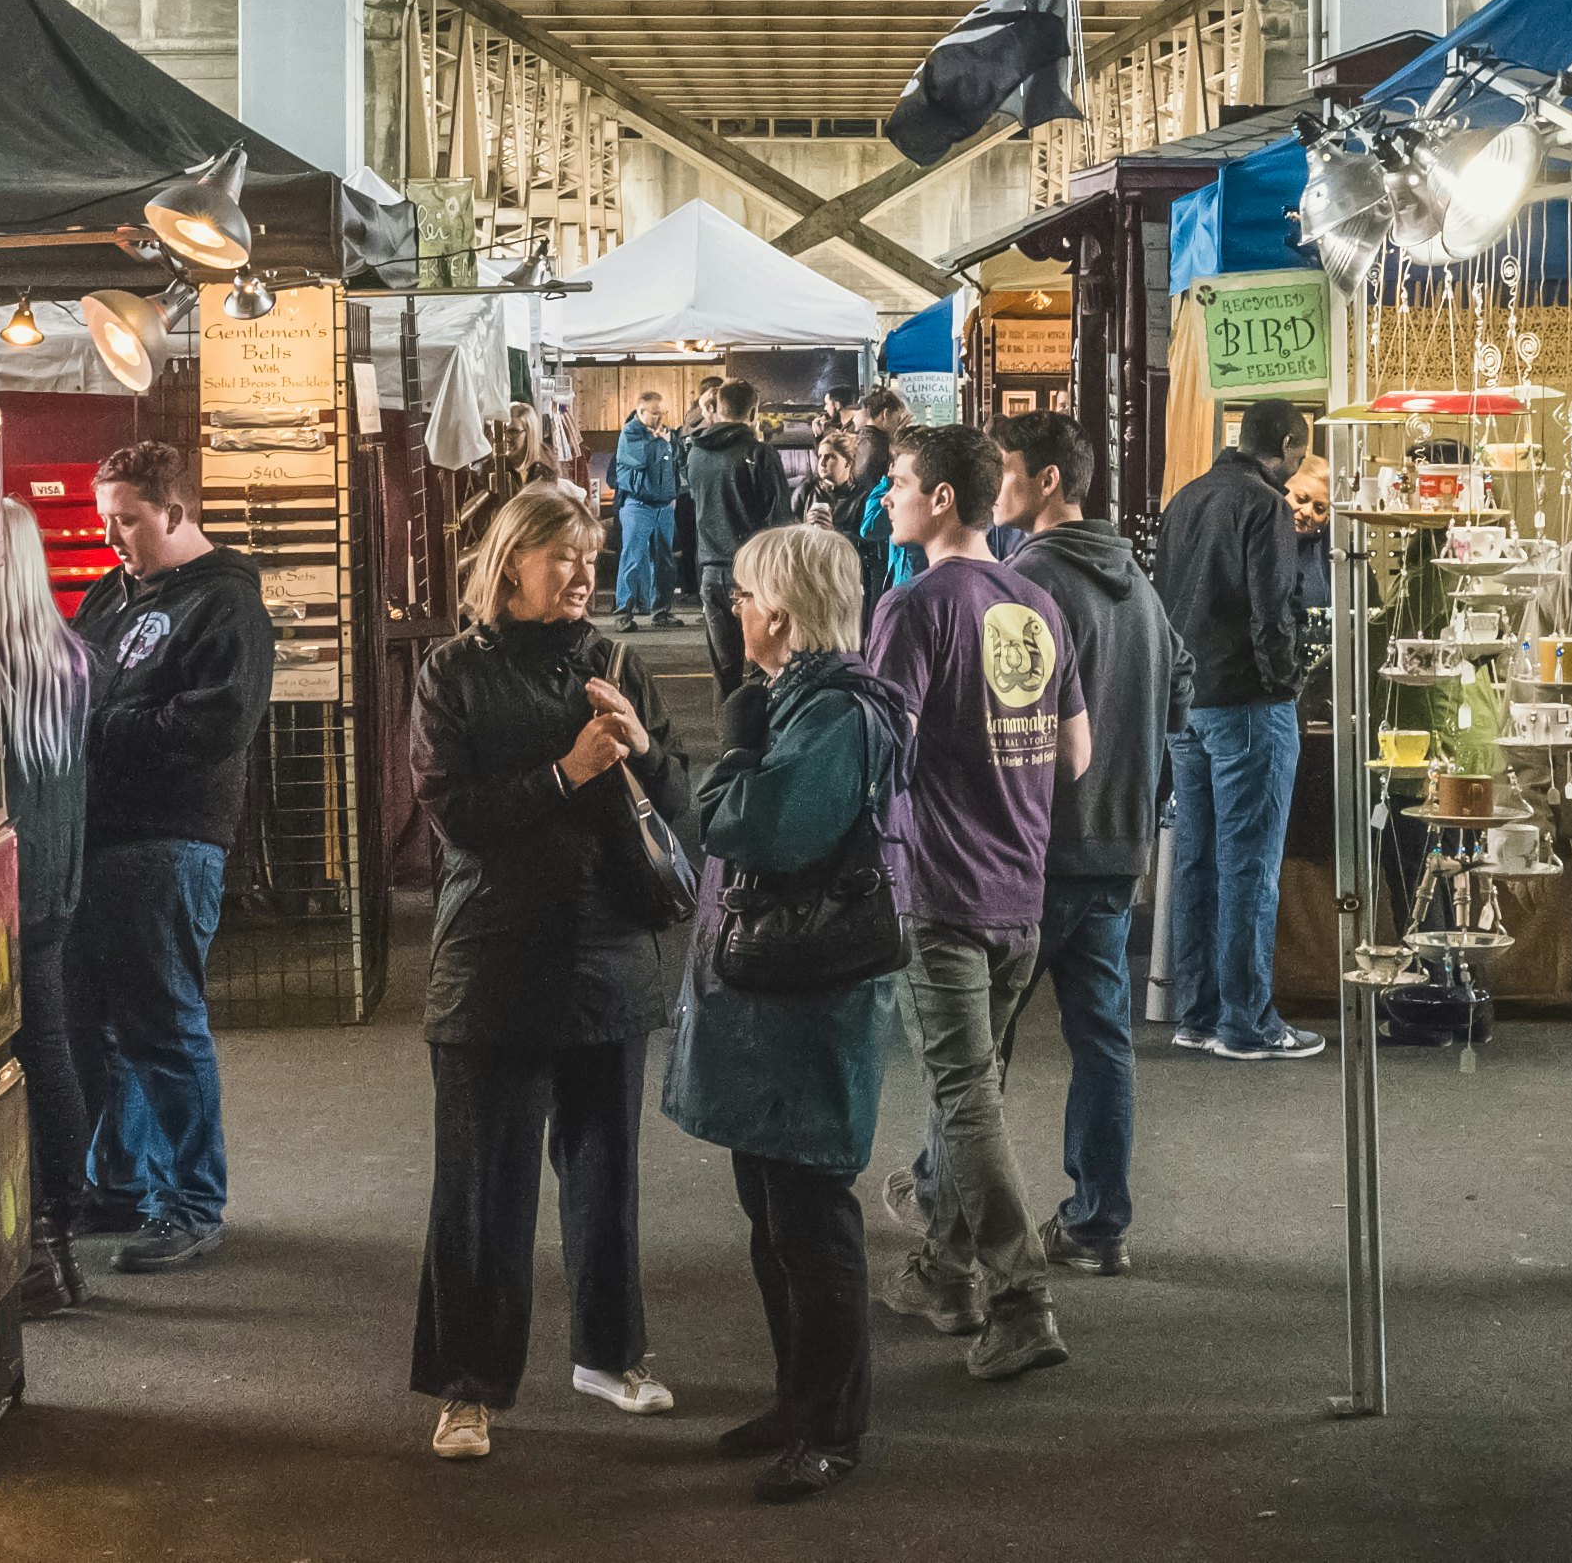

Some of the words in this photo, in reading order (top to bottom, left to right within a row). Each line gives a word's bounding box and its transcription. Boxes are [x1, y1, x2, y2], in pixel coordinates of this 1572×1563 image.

[1221, 293, 1305, 315] RECYCLED
[204, 322, 328, 340] Gentlemen's
[1214, 316, 1316, 359] BIRD
[241, 343, 292, 360] Belts
[252, 363, 280, 374] With
[1246, 359, 1317, 379] FEEDERS
[203, 377, 235, 390] Solid
[239, 377, 277, 389] Brass
[281, 375, 330, 388] Buckles
[905, 383, 951, 393] CLINICAL
[251, 390, 281, 405] $35
[253, 466, 283, 479] $40
[35, 485, 61, 495] VISA
[286, 570, 316, 582] Sets
[261, 585, 285, 598] 50
